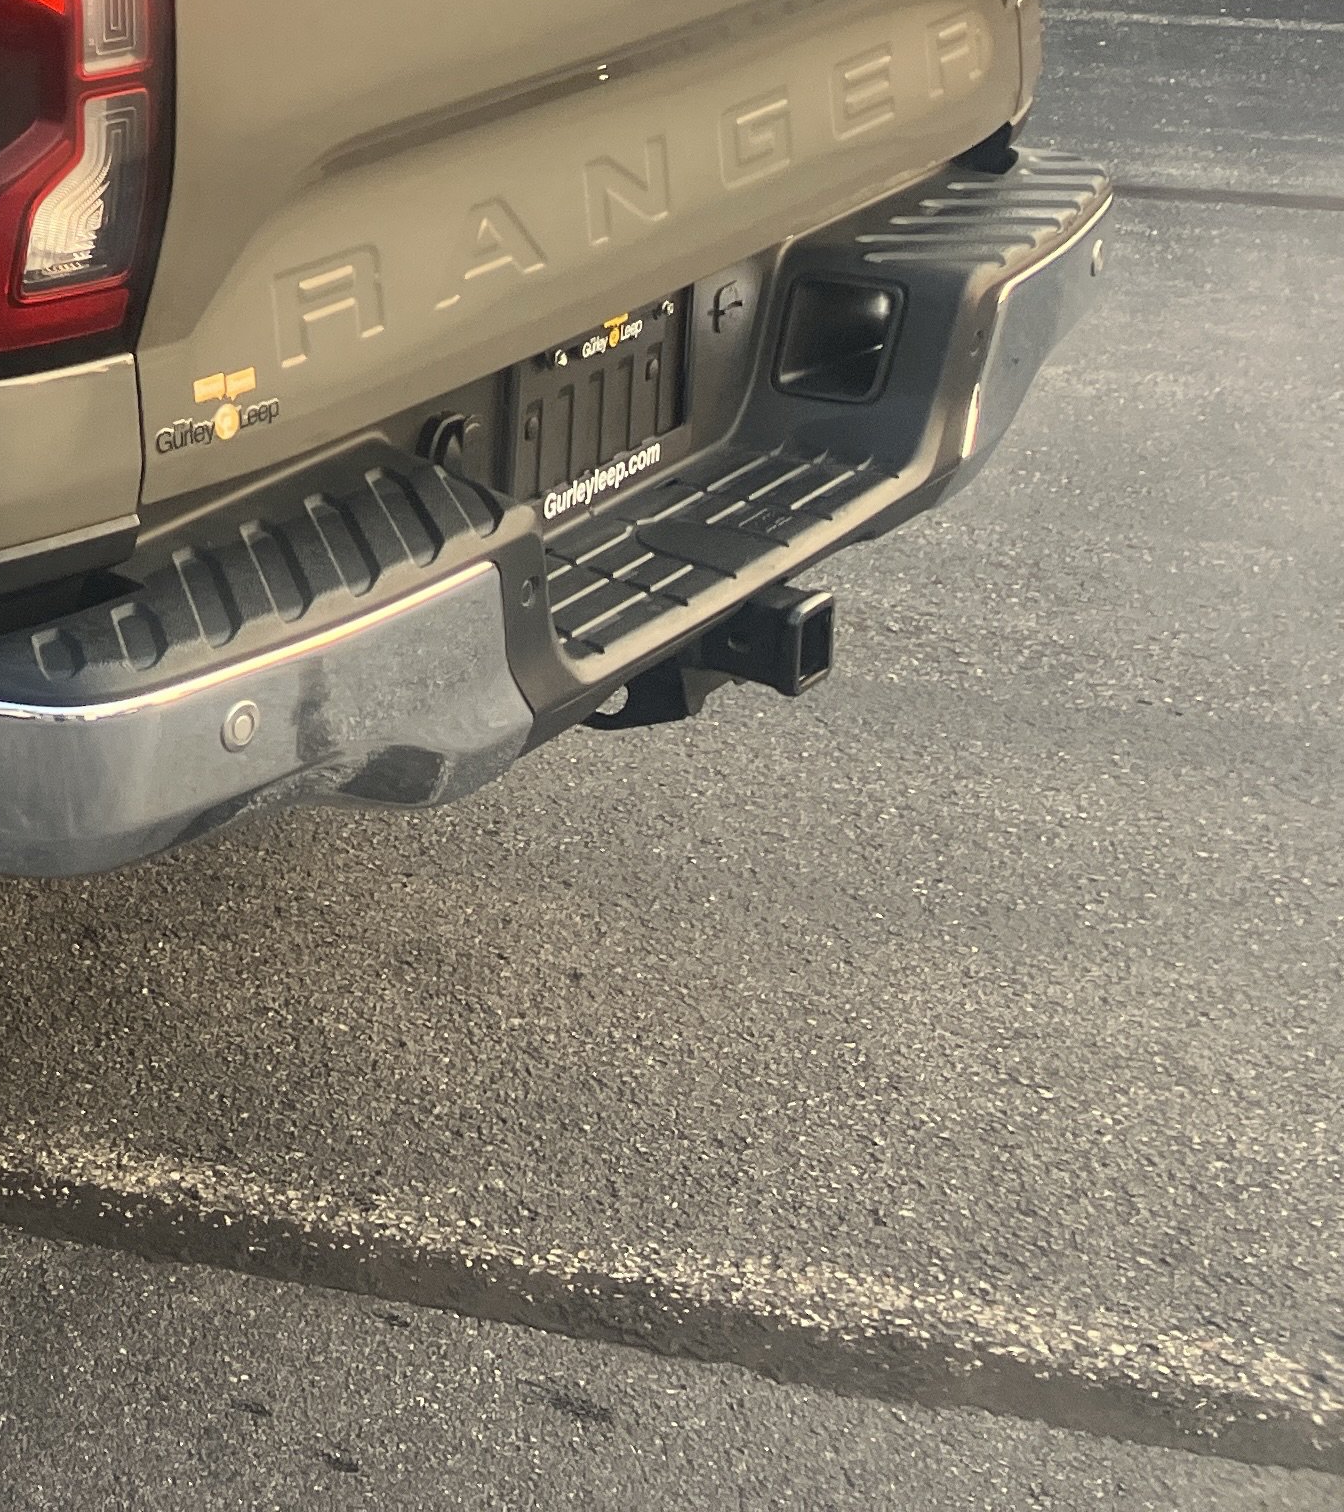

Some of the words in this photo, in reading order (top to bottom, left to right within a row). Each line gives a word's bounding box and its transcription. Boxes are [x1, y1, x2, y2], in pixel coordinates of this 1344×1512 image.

[272, 10, 984, 368] RANGER
[238, 397, 280, 430] Leep
[543, 442, 661, 520] Gurleyleep.com
